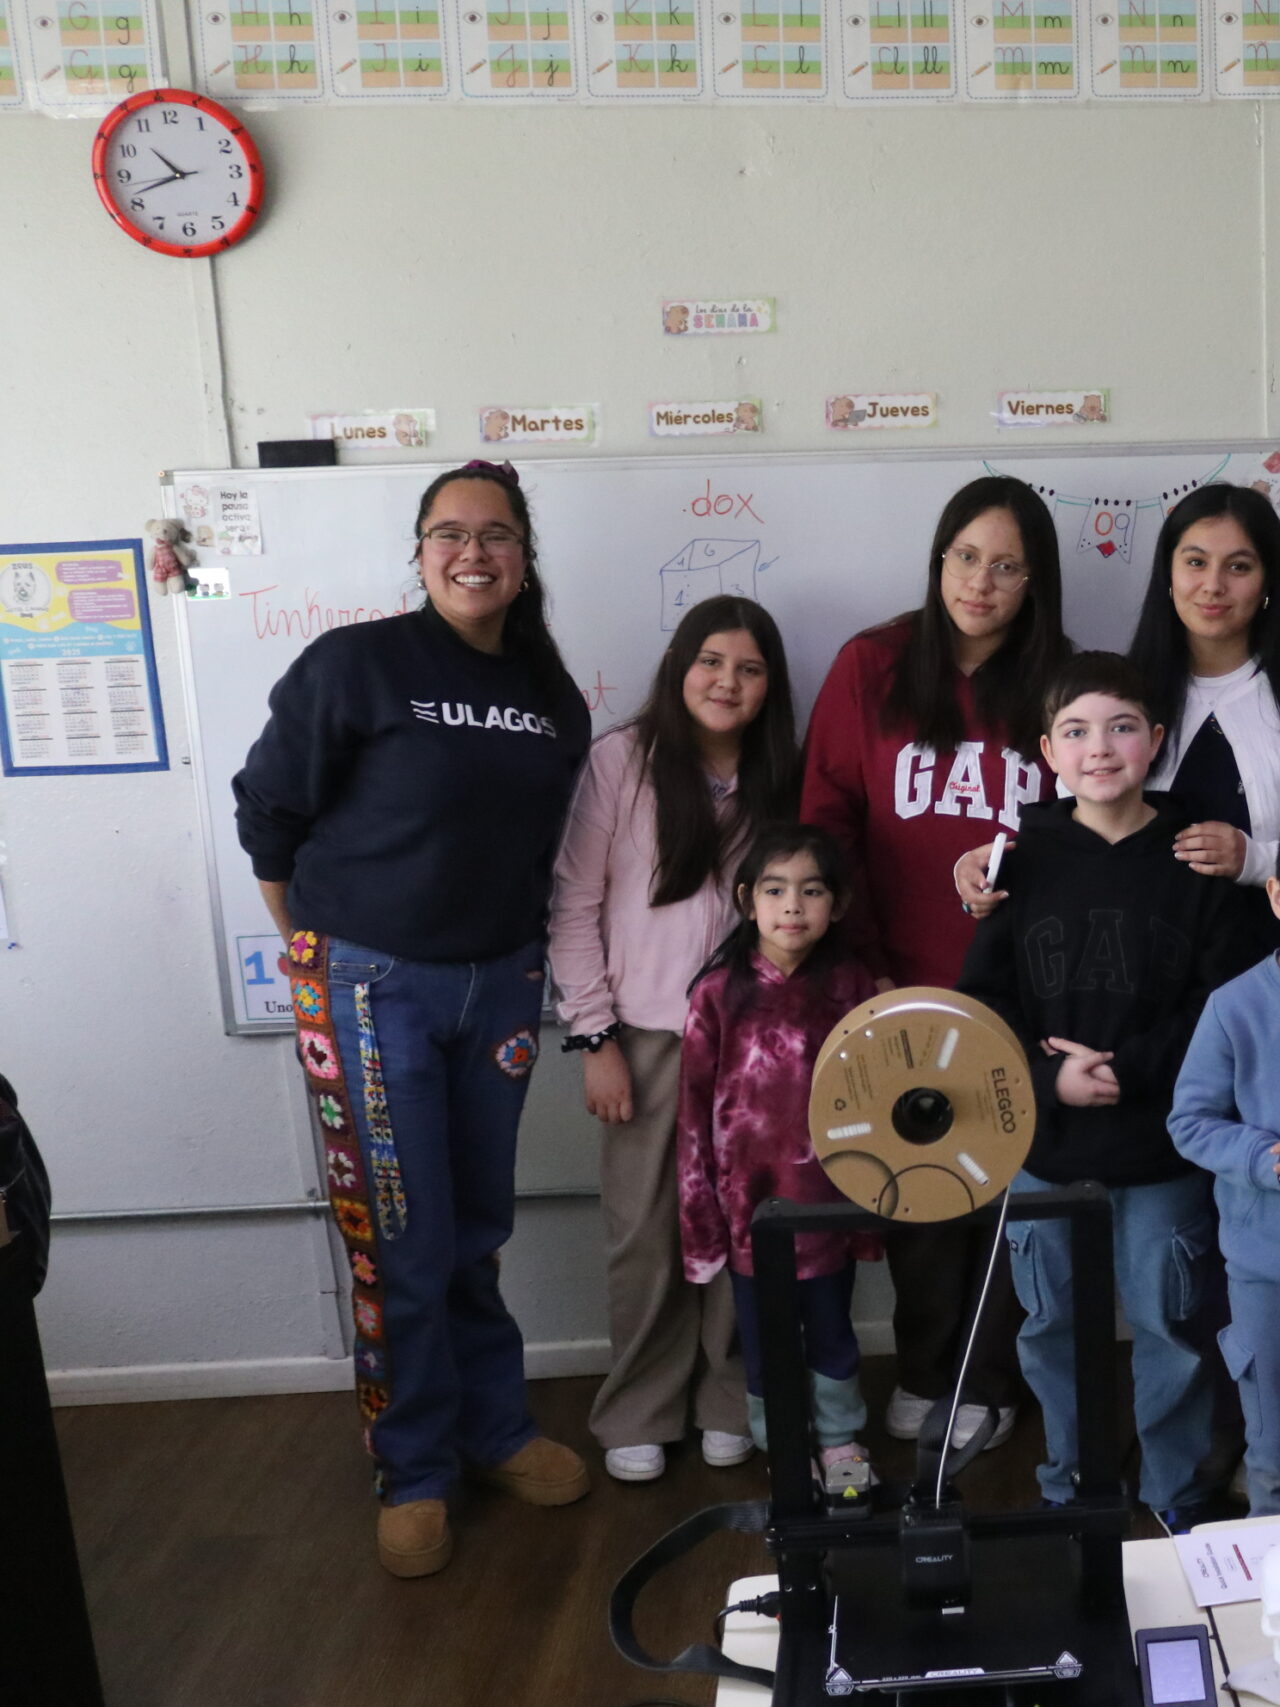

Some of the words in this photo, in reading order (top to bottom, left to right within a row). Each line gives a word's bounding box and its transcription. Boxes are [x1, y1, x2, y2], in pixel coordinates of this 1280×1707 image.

[239, 0, 260, 26] H
[288, 0, 302, 26] h
[415, 5, 421, 25] i
[668, 0, 681, 26] k
[752, 0, 770, 28] L
[1000, 1, 1026, 28] M
[1042, 15, 1063, 28] m
[1128, 0, 1147, 28] N
[1172, 14, 1184, 28] n
[67, 2, 91, 30] G
[115, 16, 131, 45] g
[542, 7, 551, 41] j
[284, 43, 309, 74] h
[414, 52, 430, 73] i
[665, 43, 689, 73] k
[794, 45, 811, 75] l
[1038, 61, 1070, 75] m
[1166, 59, 1191, 74] n
[117, 64, 138, 94] g
[543, 52, 560, 87] j
[136, 118, 152, 133] 11
[161, 109, 179, 125] 12
[196, 116, 206, 132] 1
[119, 143, 137, 158] 10
[218, 138, 233, 154] 2
[117, 168, 132, 184] 9
[228, 164, 243, 180] 3
[130, 197, 145, 212] 8
[226, 191, 240, 207] 4
[151, 216, 166, 231] 7
[181, 221, 197, 237] 6
[211, 215, 226, 231] 5
[865, 401, 930, 420] Jueves
[1006, 398, 1076, 418] Viernes
[510, 414, 585, 434] Martes
[655, 409, 735, 428] Miércoles
[329, 421, 387, 440] Lunes
[220, 491, 237, 501] Hay
[441, 702, 557, 738] ULAGOS
[894, 740, 1042, 833] GAP
[1023, 907, 1194, 1000] GAP
[244, 950, 276, 986] 1
[264, 1000, 294, 1014] Uno
[991, 1066, 1018, 1135] ELEGOO
